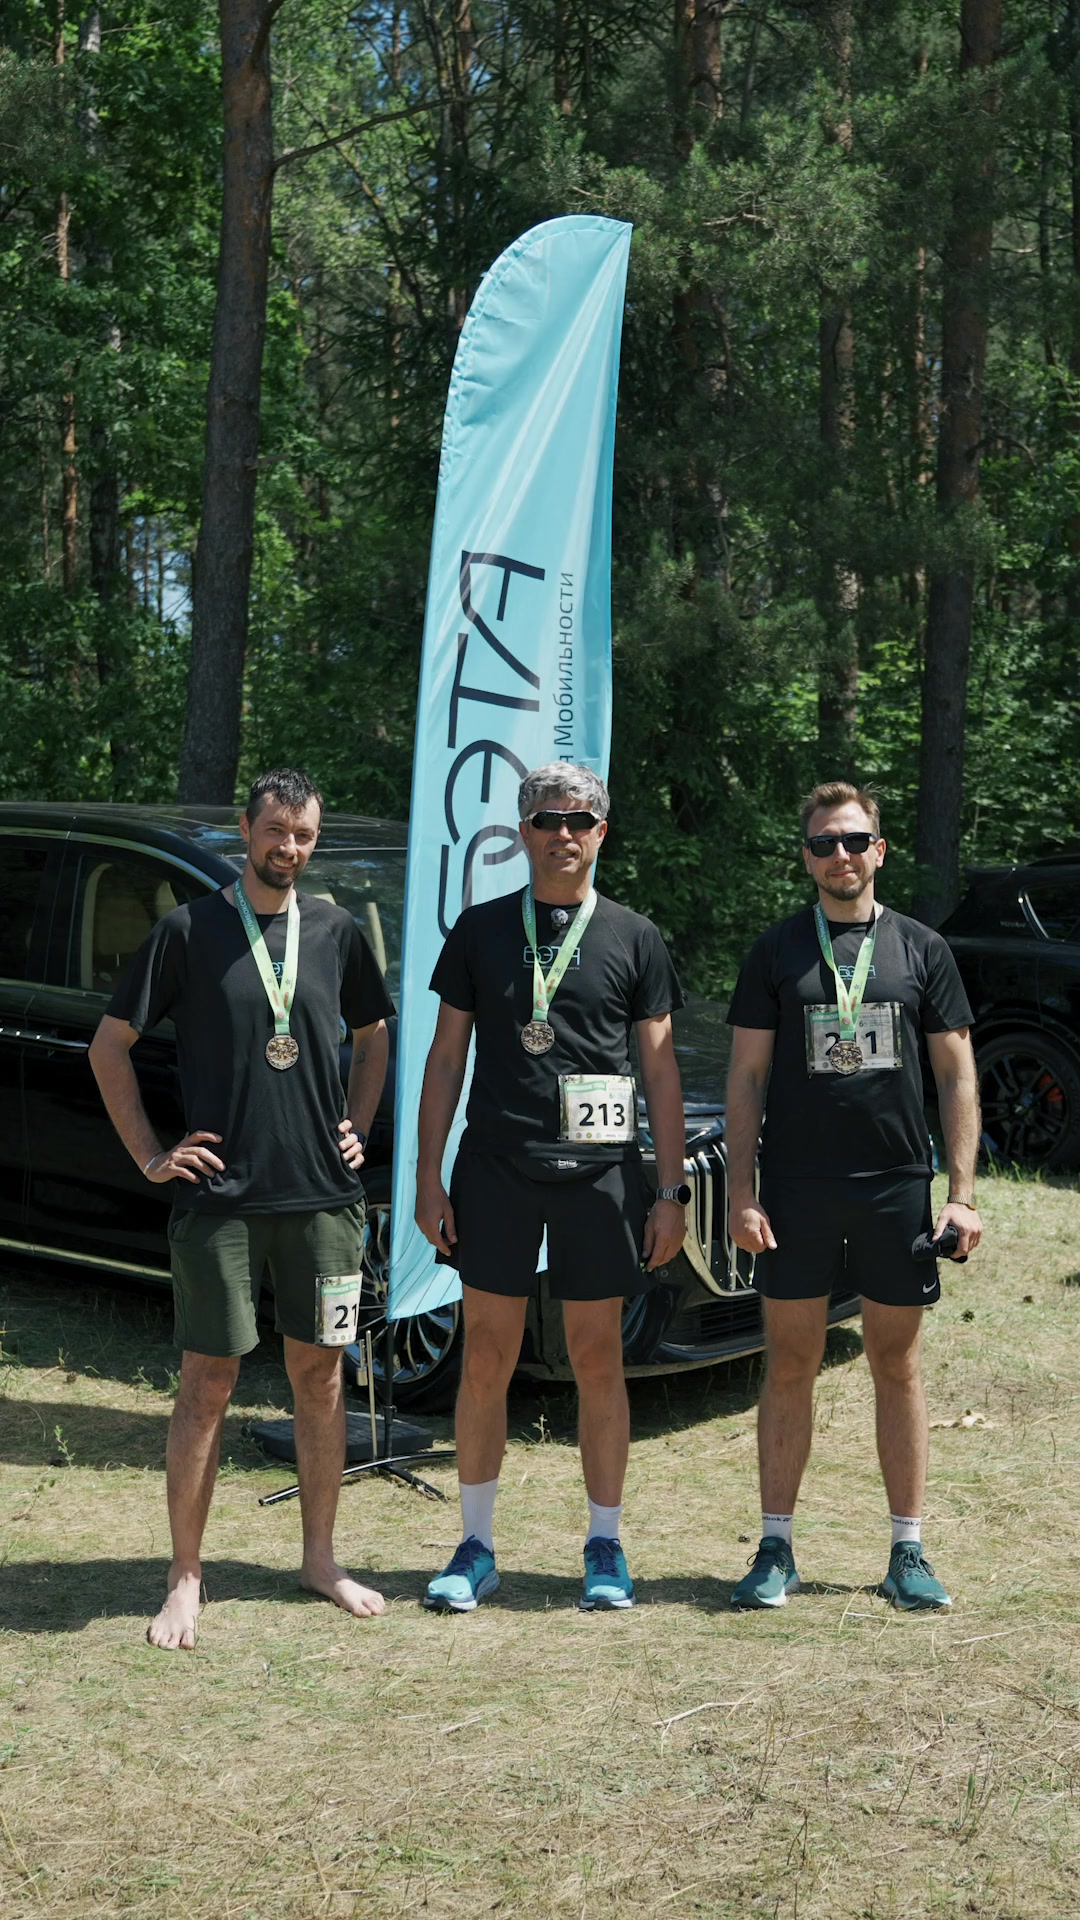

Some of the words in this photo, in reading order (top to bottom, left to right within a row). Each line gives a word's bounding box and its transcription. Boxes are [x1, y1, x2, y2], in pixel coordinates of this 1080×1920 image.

[552, 572, 574, 746] Мобильности
[236, 890, 257, 937] НАЛИБОКСКИЕ
[825, 1030, 877, 1056] 21
[578, 1102, 626, 1127] 213
